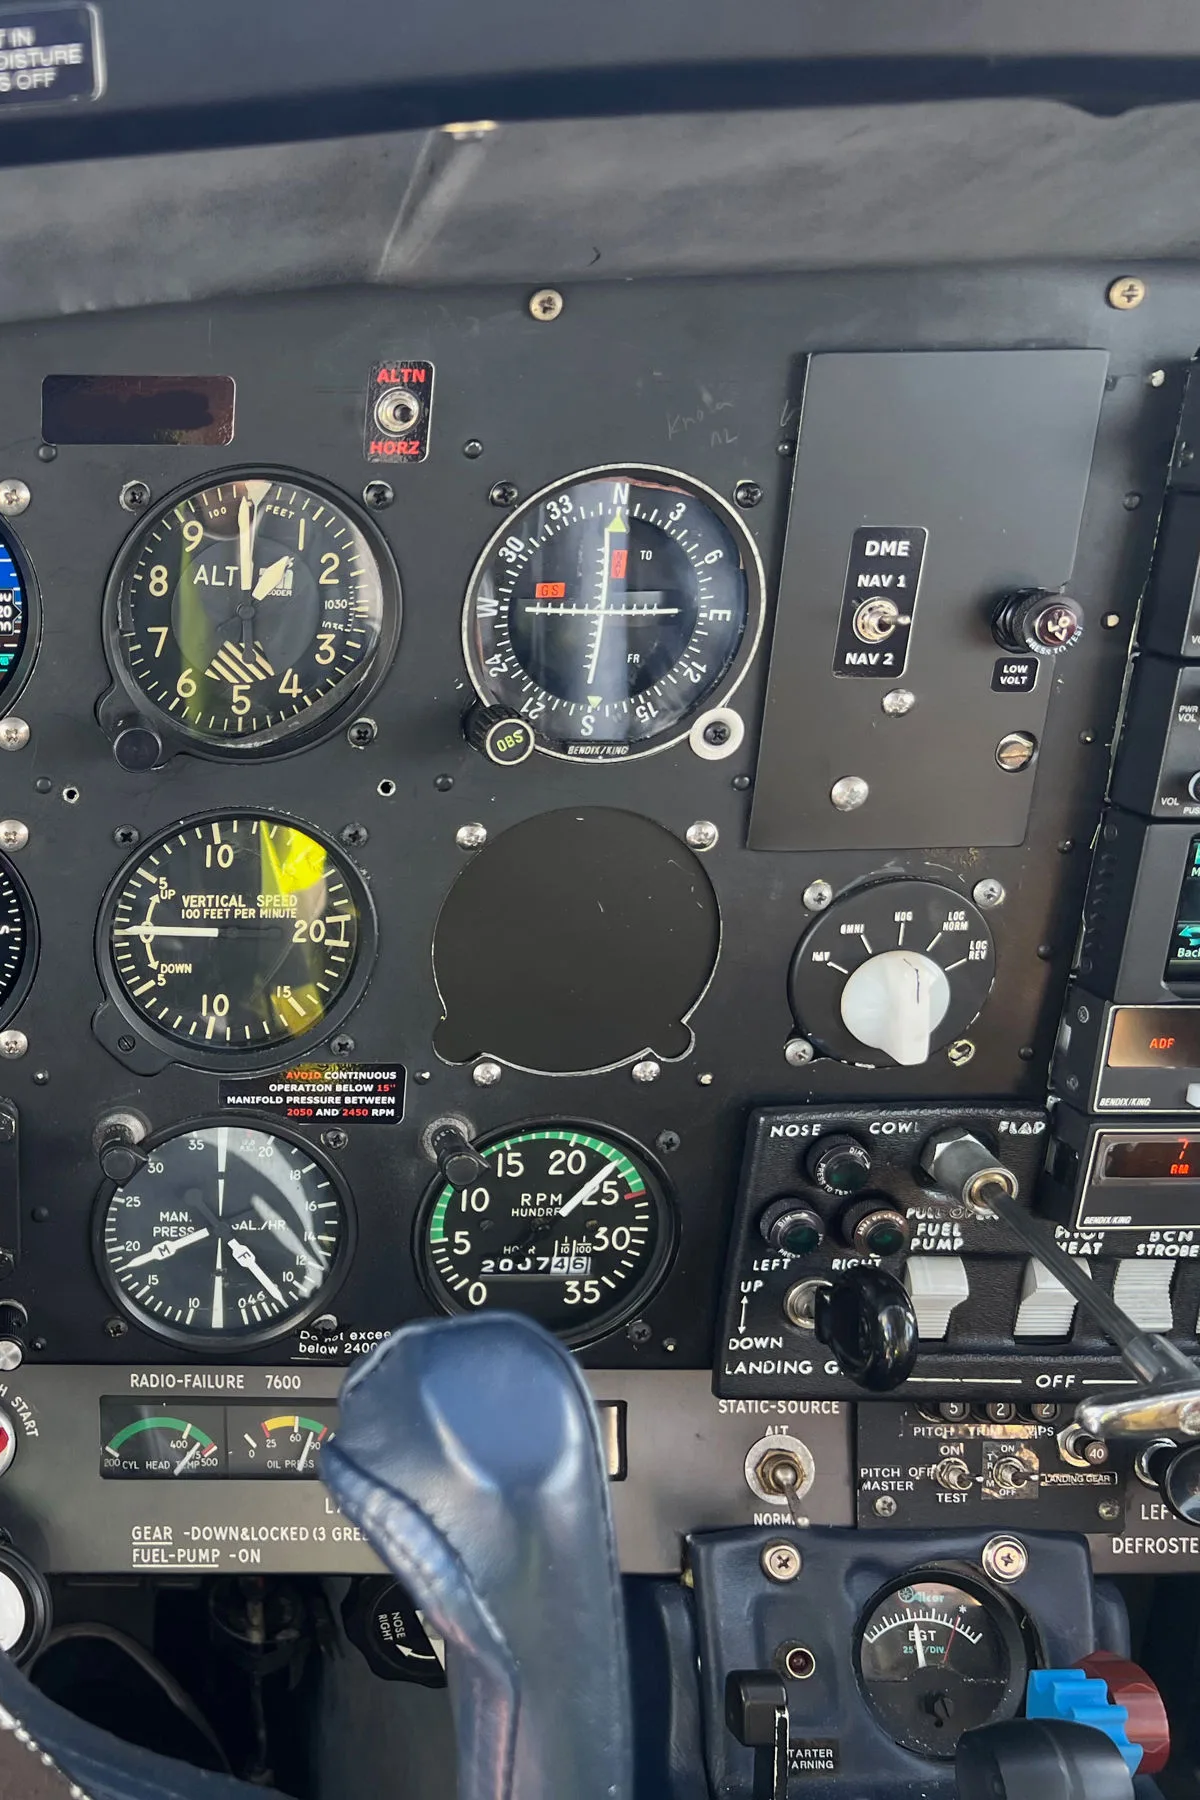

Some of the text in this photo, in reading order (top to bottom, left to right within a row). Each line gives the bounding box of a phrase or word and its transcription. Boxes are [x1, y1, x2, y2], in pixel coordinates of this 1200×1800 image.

[10, 27, 33, 47] IN
[16, 68, 56, 90] OFF
[377, 369, 425, 383] ALTN
[370, 441, 419, 454] HORZ
[613, 484, 629, 504] N
[265, 504, 295, 519] FEET
[546, 495, 573, 520] 33
[865, 541, 910, 556] DME
[640, 551, 652, 560] TO
[194, 566, 238, 585] ALT
[857, 575, 906, 587] NAV 1
[541, 585, 559, 595] GS
[325, 600, 347, 609] 1030
[628, 654, 640, 664] FR
[845, 653, 893, 665] NAV 2
[1003, 665, 1028, 674] LOW
[1000, 676, 1027, 685] VOLT
[496, 730, 524, 752] OBS
[568, 746, 628, 755] BENDIX/KING
[205, 844, 234, 868] 10
[160, 890, 176, 899] UP
[182, 895, 297, 907] VERTICAL SPEED
[182, 908, 297, 918] 100 FEET PER MINUTE
[948, 911, 964, 921] LOC
[292, 920, 326, 942] 20
[942, 921, 968, 931] NORM
[970, 941, 987, 950] LOC
[969, 950, 986, 960] REV
[161, 964, 192, 973] DOWN
[1150, 1038, 1175, 1049] ADF
[286, 1071, 396, 1080] AVOID CONTINUOUS
[269, 1084, 333, 1092] OPERATION
[335, 1084, 374, 1092] BELOW
[227, 1096, 395, 1104] MANIFOLD PRESSURE BETWEEN
[1100, 1098, 1151, 1107] BENDIX/KING
[287, 1109, 312, 1117] 2050
[342, 1108, 368, 1116] 2450
[770, 1124, 821, 1137] NOSE
[497, 1152, 524, 1177] 15
[548, 1150, 586, 1175] 20
[160, 1212, 192, 1222] MAN.
[917, 1224, 960, 1237] FUEL
[911, 1238, 963, 1250] PUMP
[1136, 1243, 1200, 1257] STROBE
[753, 1258, 791, 1271] LEFT
[741, 1280, 762, 1292] UP
[729, 1337, 783, 1349] DOWN
[725, 1360, 812, 1374] LANDING
[130, 1374, 300, 1389] RADIO-FAILURE 7600
[1036, 1374, 1075, 1388] OFF
[718, 1401, 839, 1414] STATIC-SOURCE
[123, 1460, 170, 1470] CYL HEAD
[1046, 1475, 1084, 1483] LANDING
[936, 1493, 968, 1503] TEST
[132, 1527, 172, 1541] GEAR
[133, 1549, 218, 1563] FUEL-PUMP
